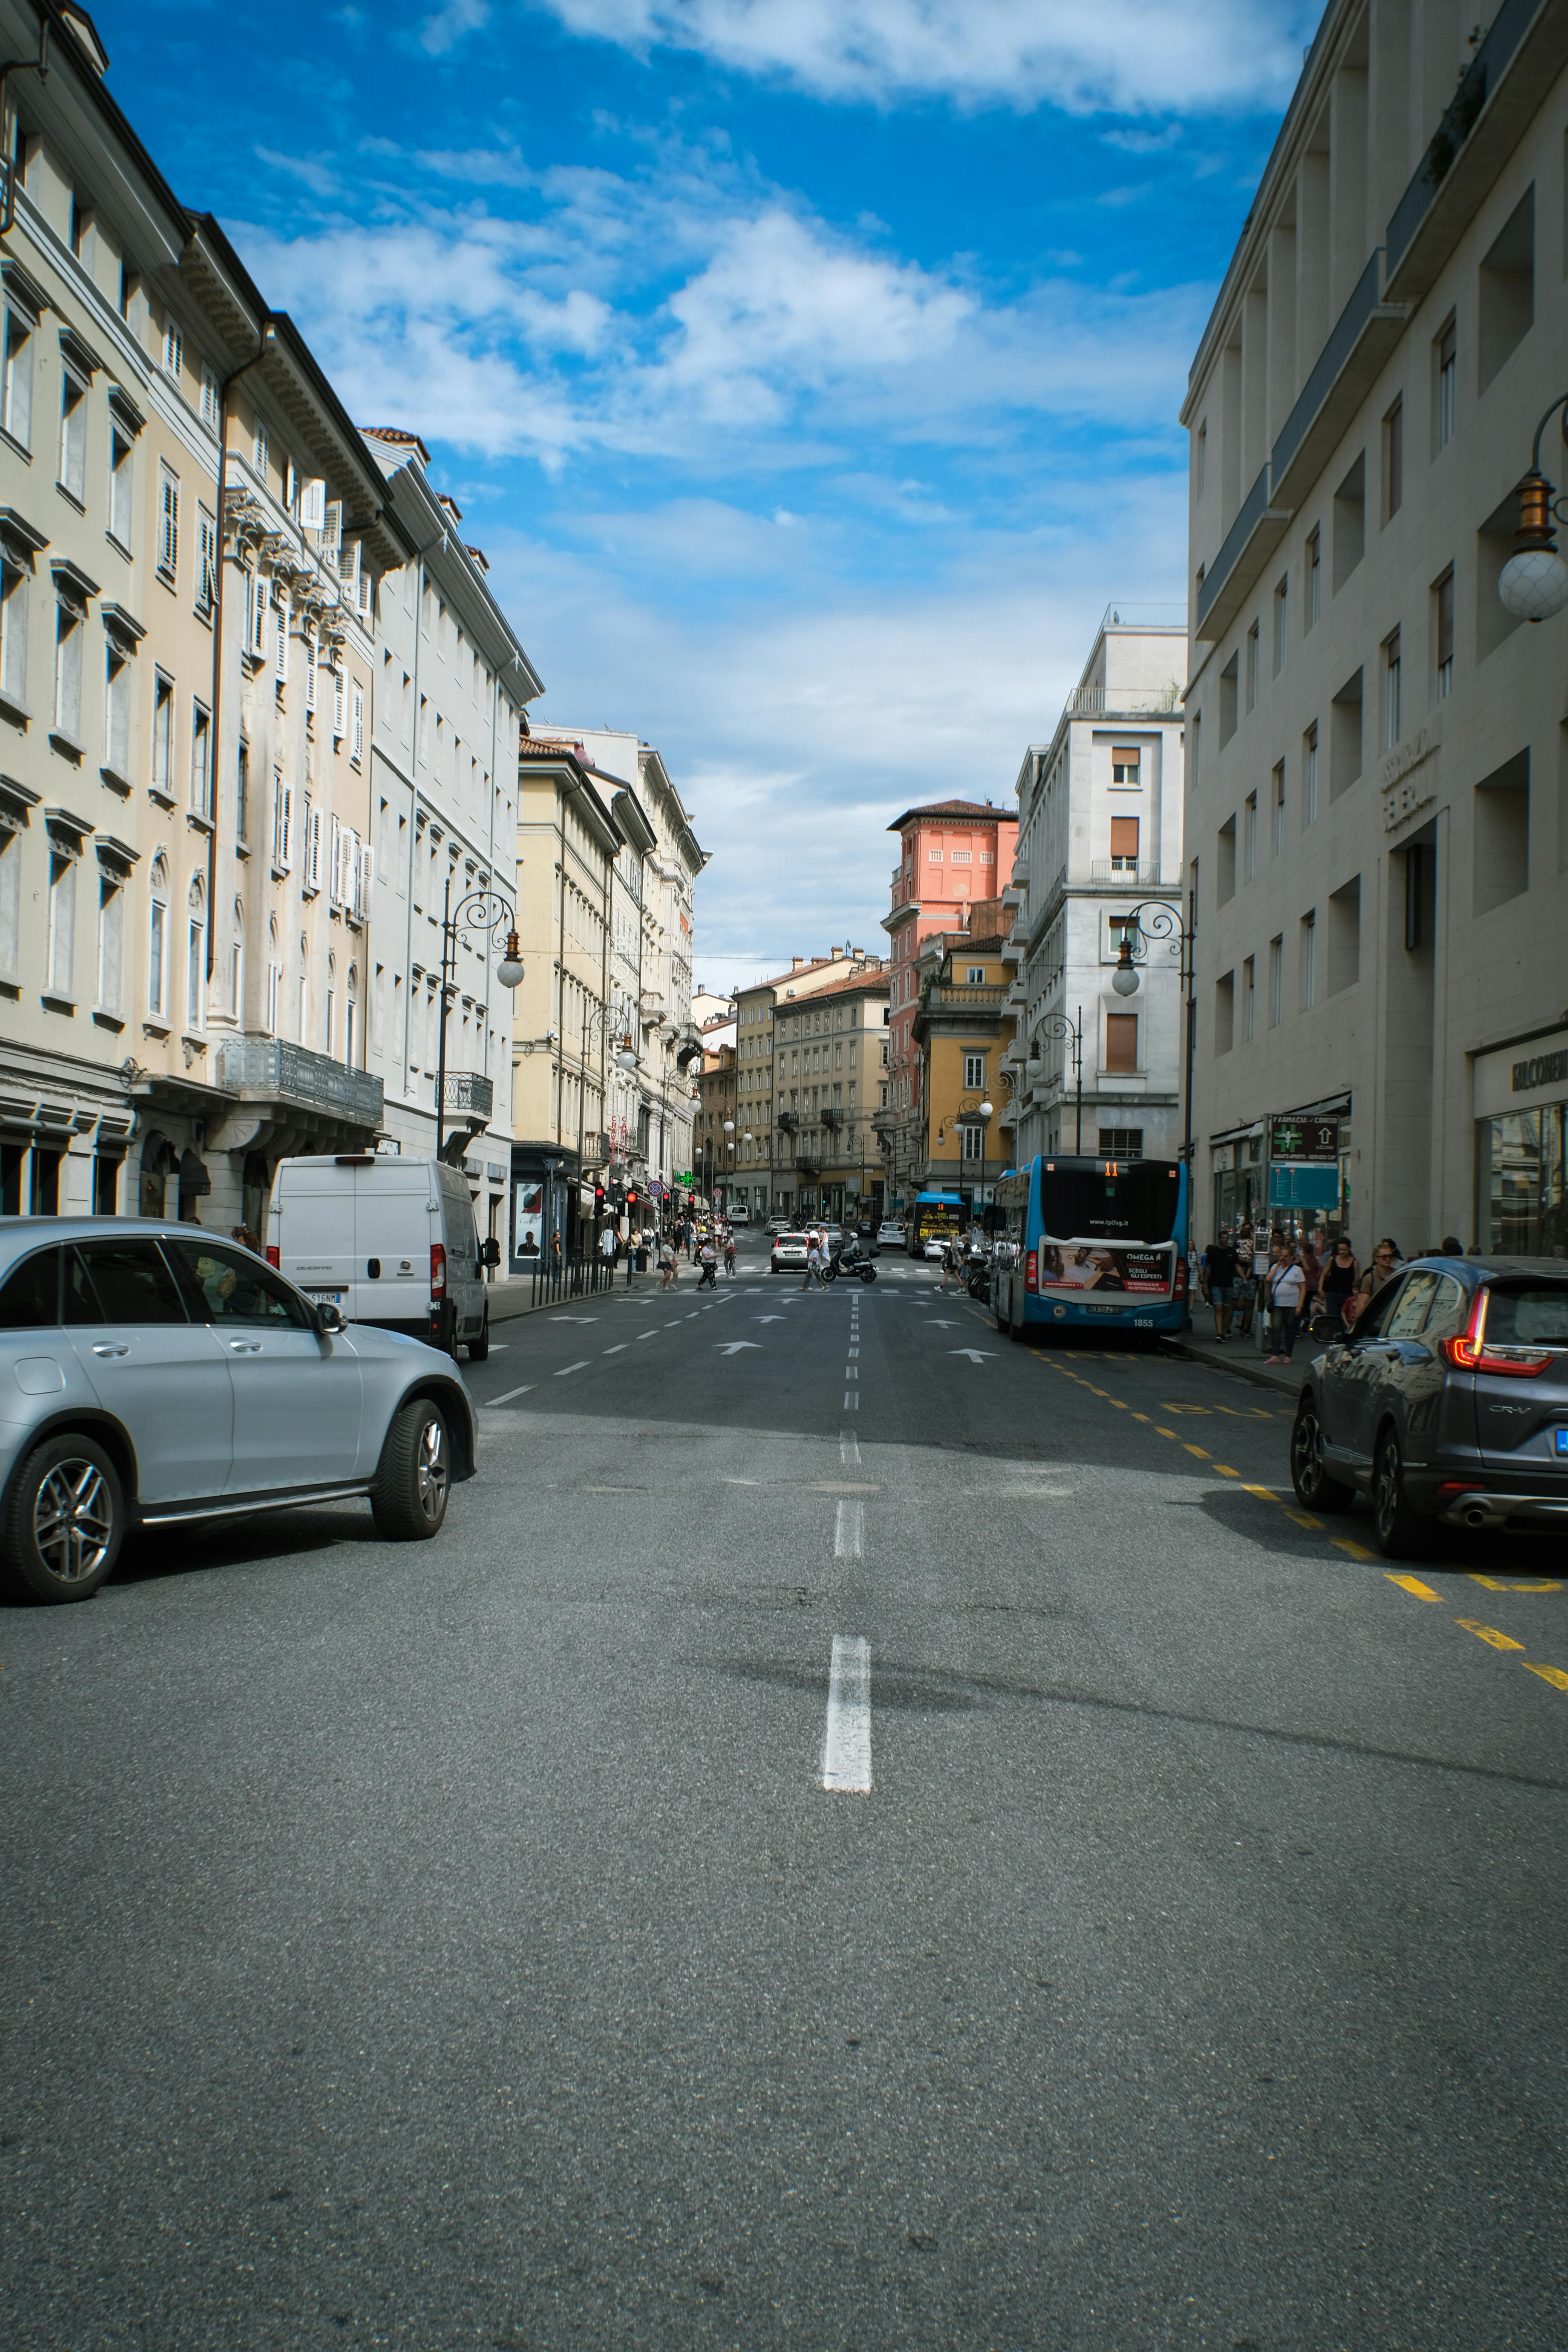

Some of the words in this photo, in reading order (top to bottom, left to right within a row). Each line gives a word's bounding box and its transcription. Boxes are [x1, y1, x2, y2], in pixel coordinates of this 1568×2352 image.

[1105, 1161, 1117, 1176] 11
[1134, 1319, 1153, 1327] 1855
[1489, 1405, 1531, 1414] CR-V
